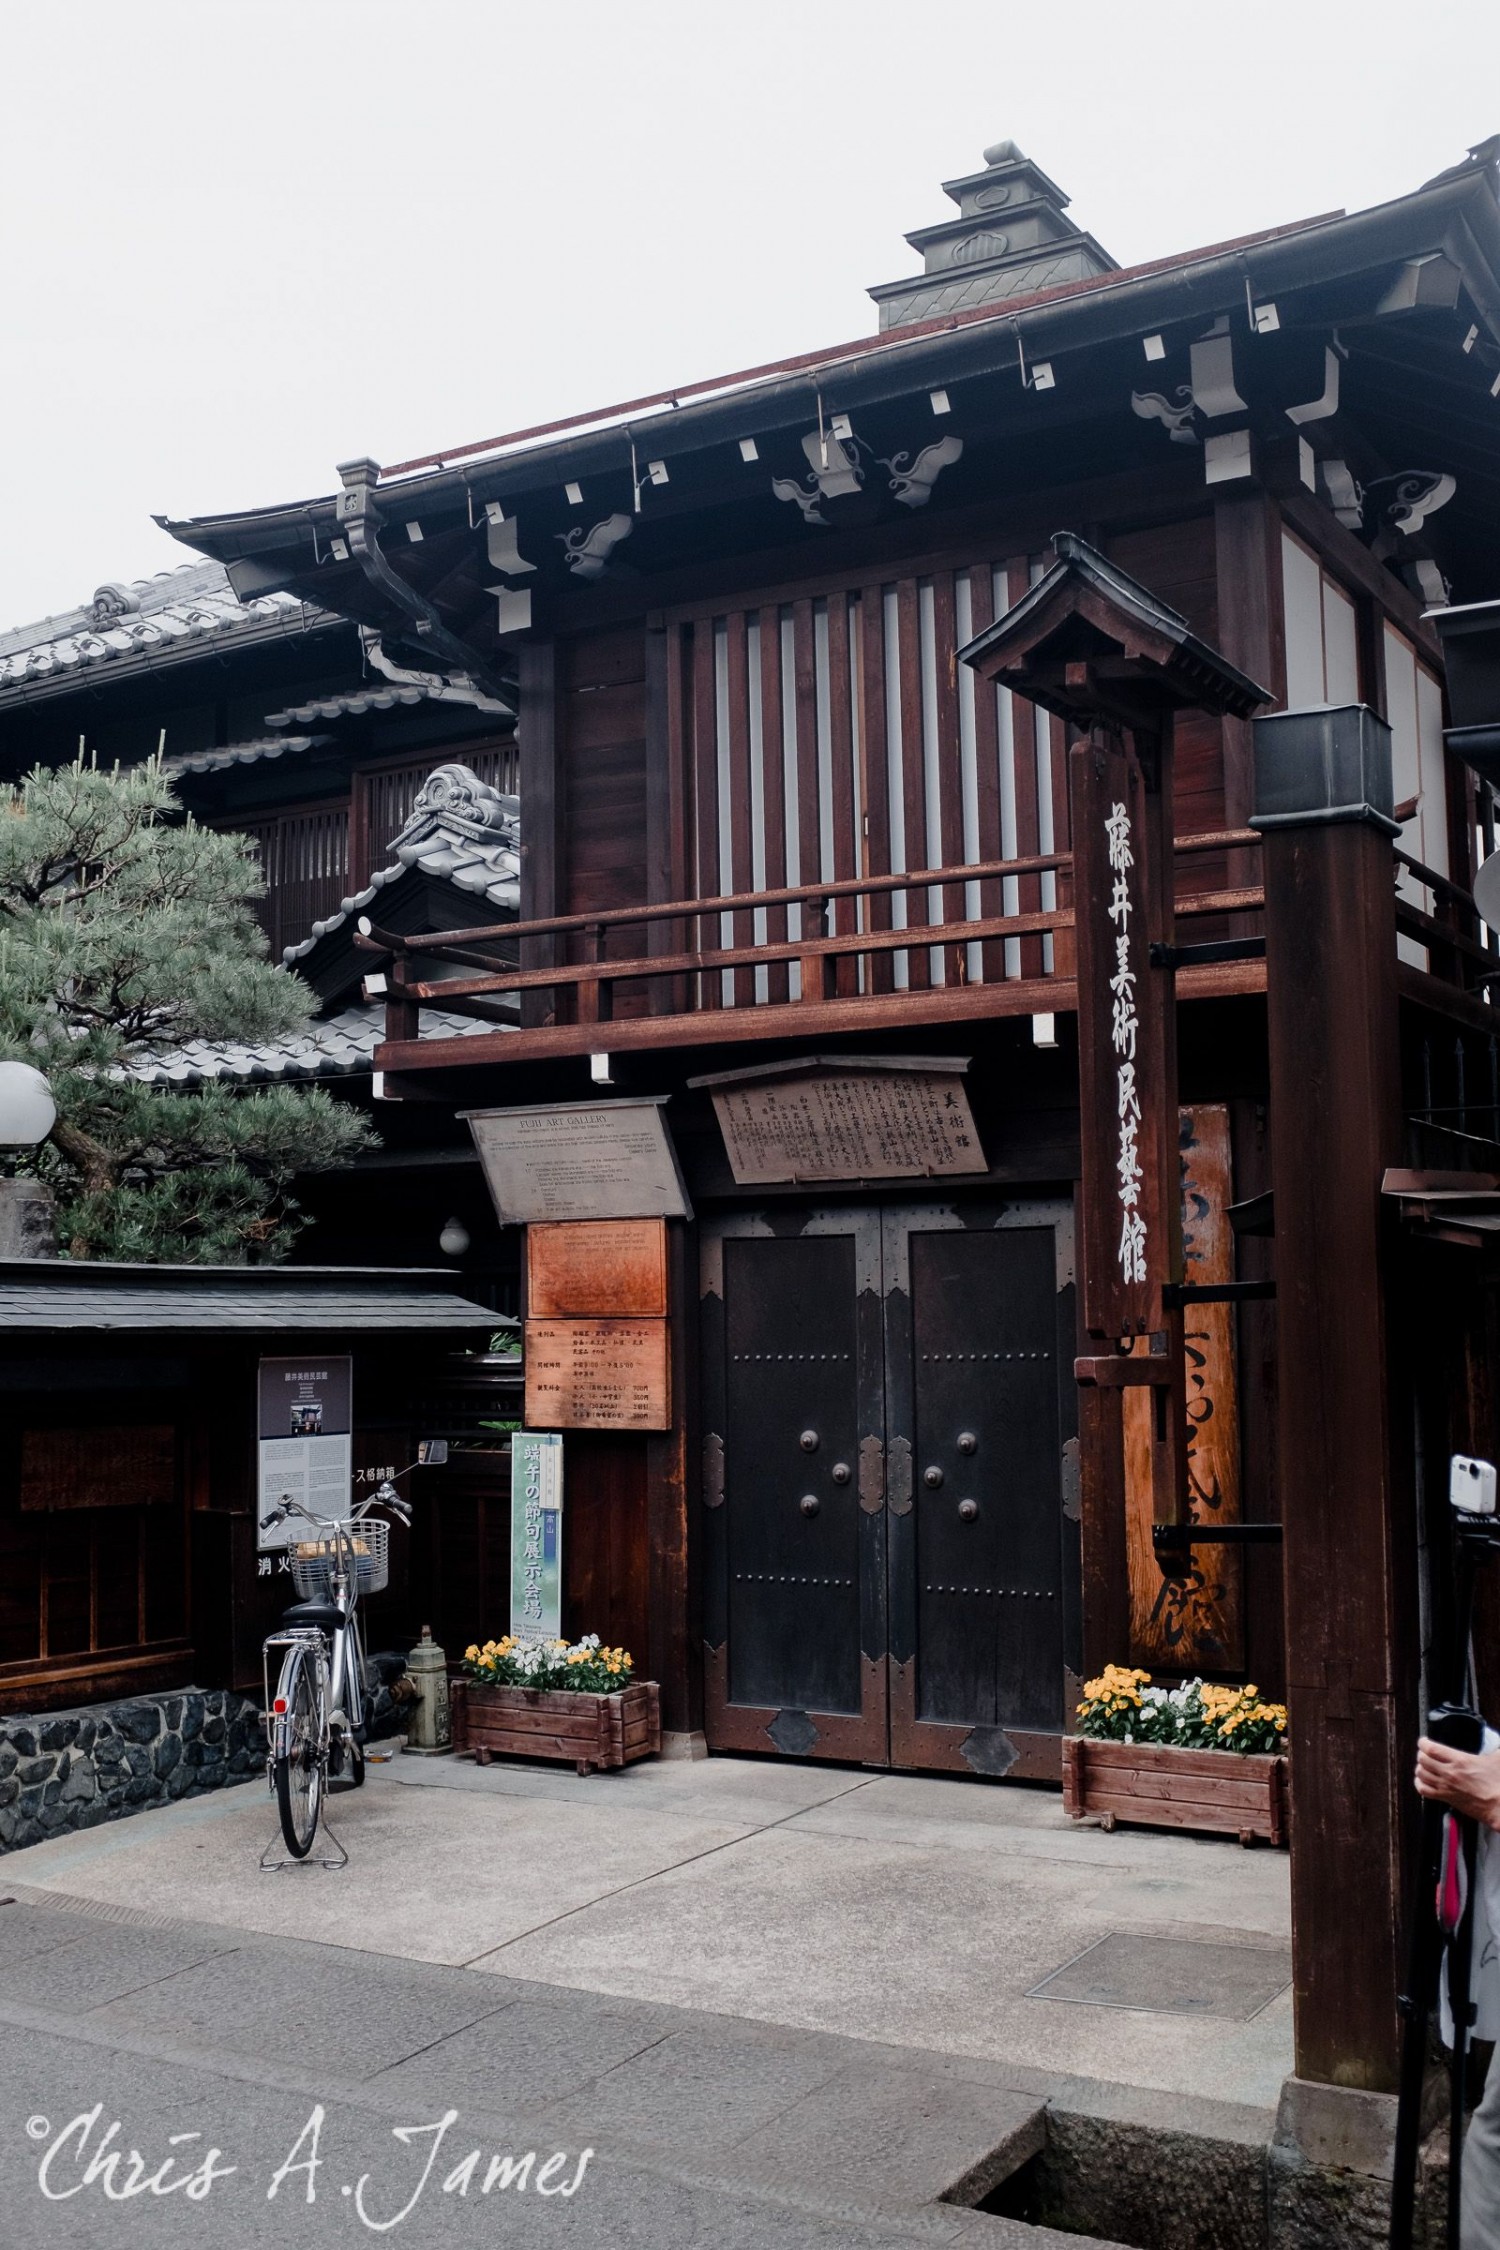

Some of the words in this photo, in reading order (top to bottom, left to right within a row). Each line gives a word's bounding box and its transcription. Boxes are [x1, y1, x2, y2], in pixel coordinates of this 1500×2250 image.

[520, 1118, 543, 1129] FUJII
[547, 1116, 565, 1127] ART
[567, 1114, 608, 1125] GALLERY
[523, 1444, 543, 1619] 端午の節句展示会場
